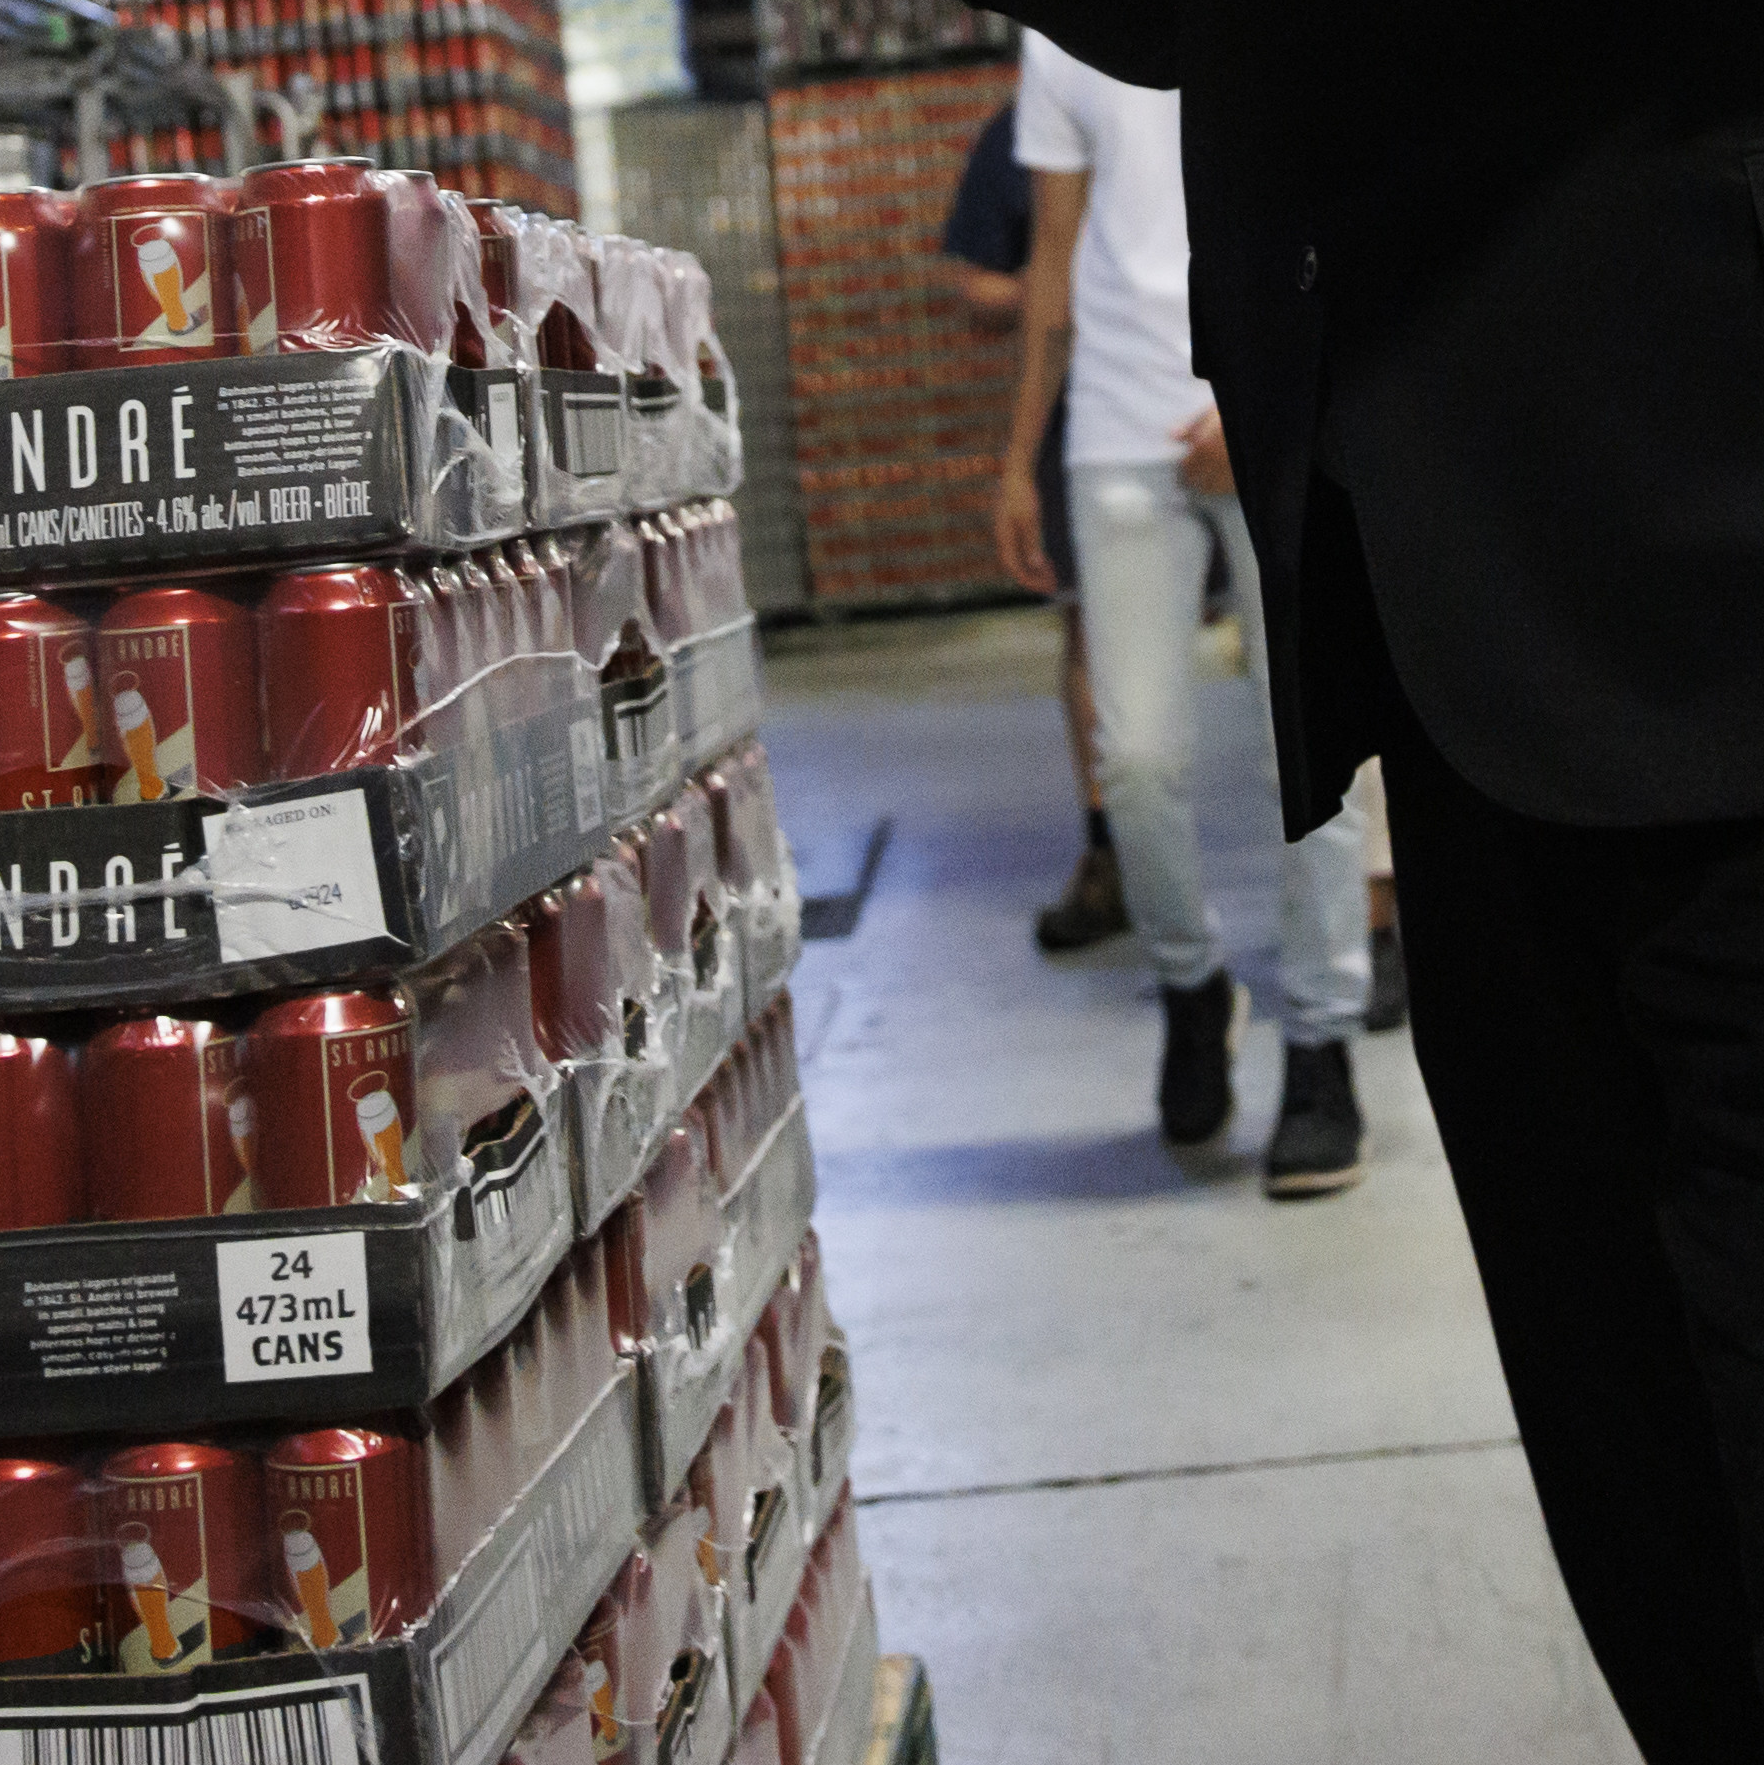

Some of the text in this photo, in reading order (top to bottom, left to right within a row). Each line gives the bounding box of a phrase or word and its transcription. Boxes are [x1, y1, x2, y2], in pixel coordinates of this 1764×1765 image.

[17, 500, 145, 550] CANS/CANETTES
[155, 494, 198, 534] 4.6%
[269, 485, 312, 524] BEER
[323, 475, 373, 520] BIÈRE
[270, 1250, 313, 1282] 24
[236, 1288, 356, 1327] 473mL
[252, 1329, 344, 1367] CANS
